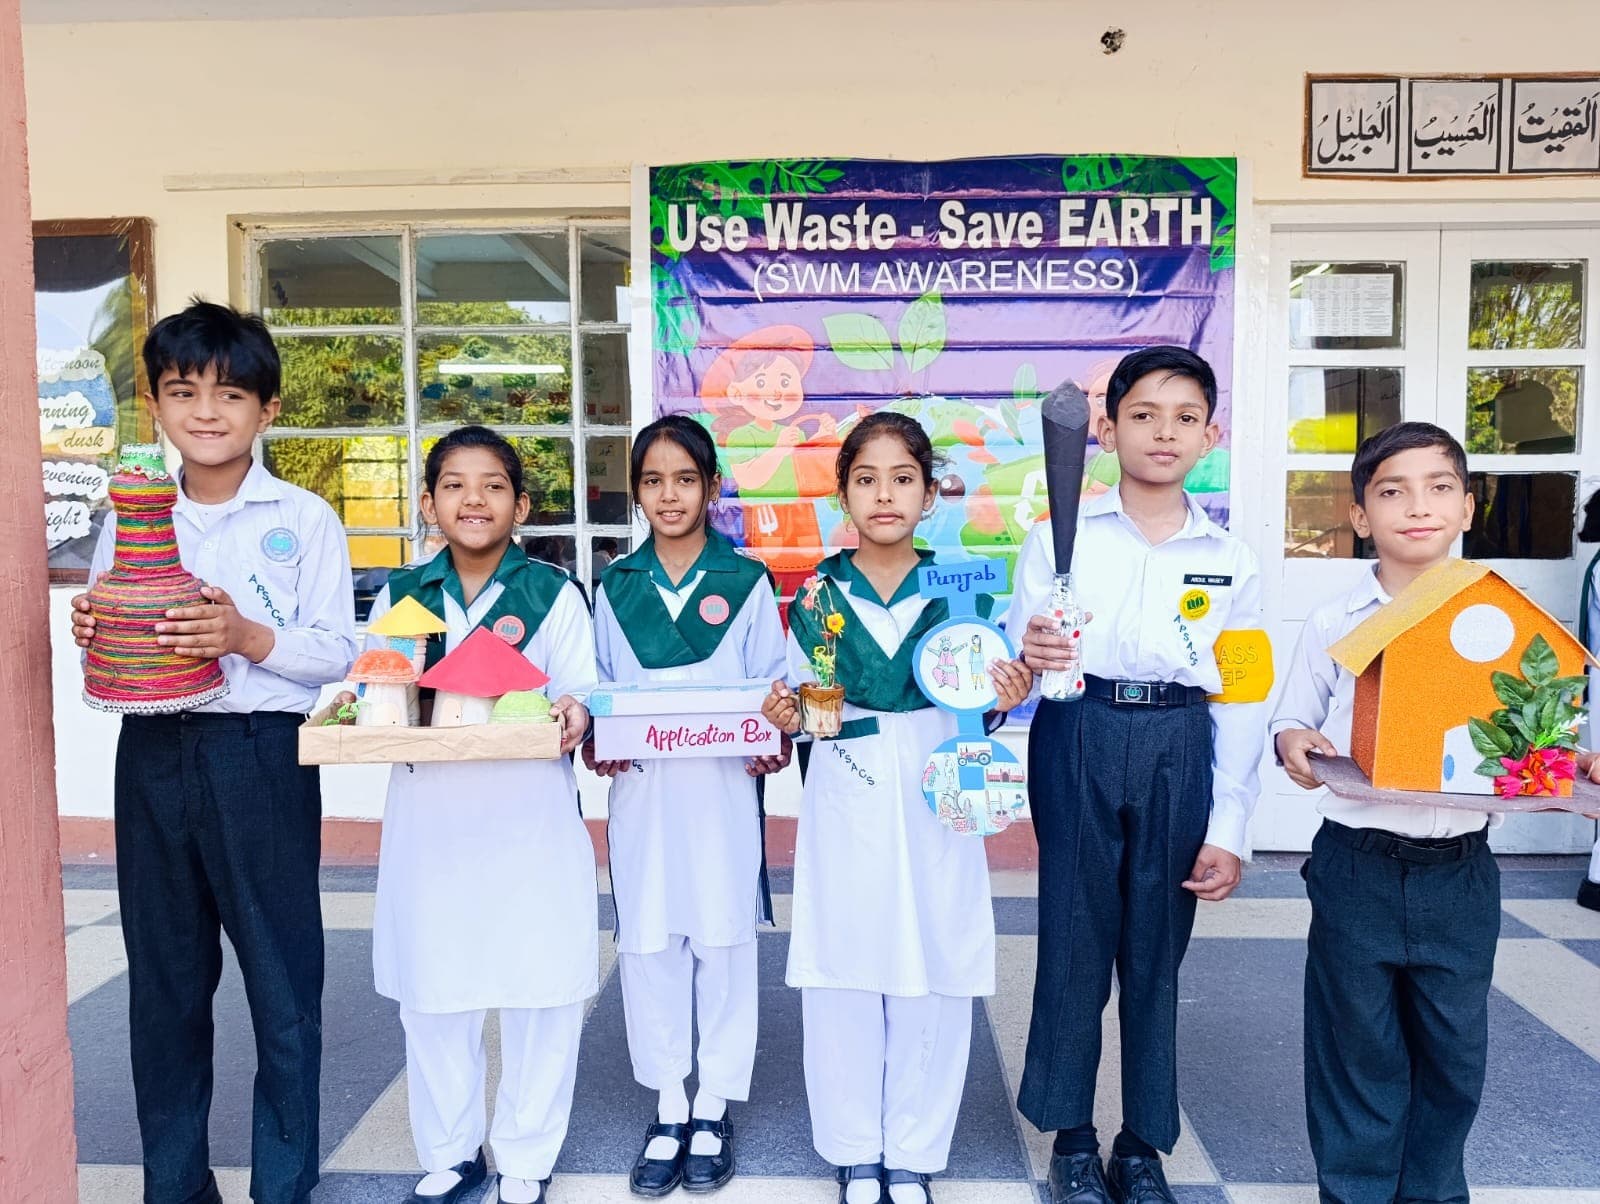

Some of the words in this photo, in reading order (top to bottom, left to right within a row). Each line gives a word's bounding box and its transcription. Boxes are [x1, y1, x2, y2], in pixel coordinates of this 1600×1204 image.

[667, 202, 749, 252] Use
[762, 201, 897, 251] Waste
[939, 200, 1044, 250] Save
[1059, 197, 1212, 248] EARTH
[753, 262, 860, 302] (SWM
[870, 258, 1139, 298] AWARENESS)
[40, 403, 90, 424] rning
[64, 430, 104, 448] dusk
[46, 506, 82, 533] ight
[248, 573, 285, 627] APSACS
[1173, 614, 1199, 667] APSACS
[1216, 644, 1259, 665] ASS
[1218, 668, 1248, 687] EP
[646, 723, 735, 751] Application
[740, 718, 772, 743] Box
[832, 742, 875, 786] APSACS
